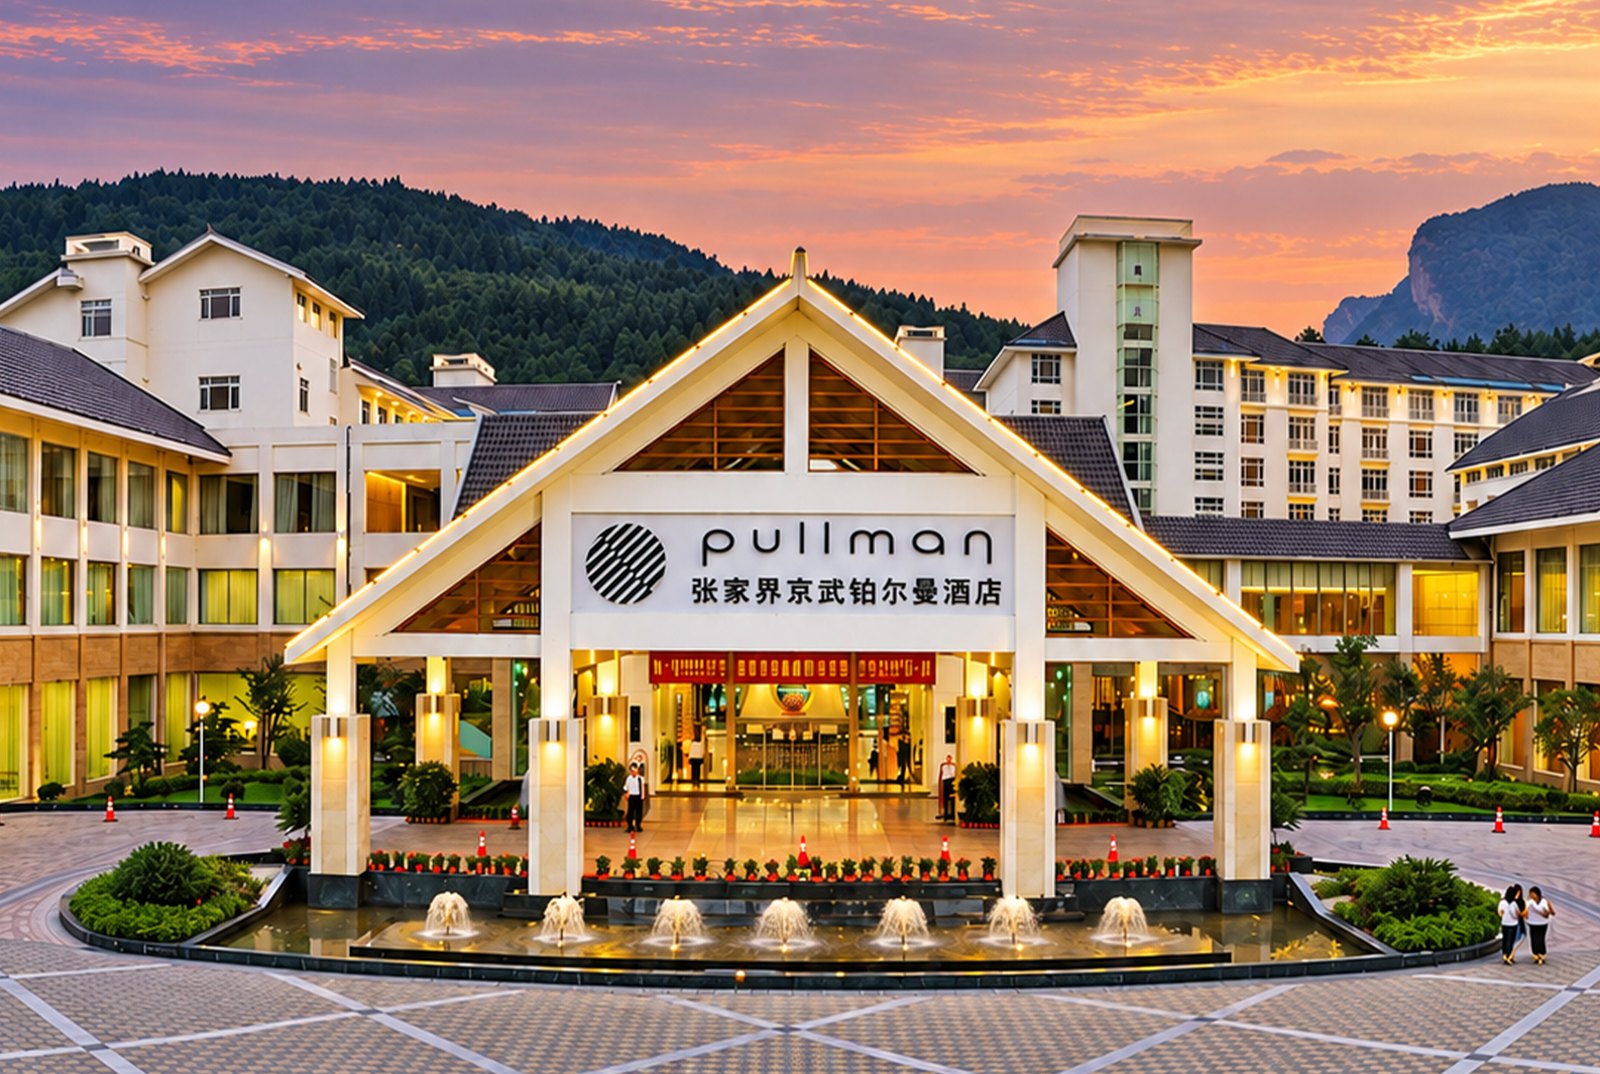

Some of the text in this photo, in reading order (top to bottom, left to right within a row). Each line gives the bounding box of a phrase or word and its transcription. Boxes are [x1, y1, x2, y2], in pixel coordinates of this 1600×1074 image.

[702, 520, 993, 568] pullman
[691, 577, 1002, 606] 张家界京武铂尔曼酒店
